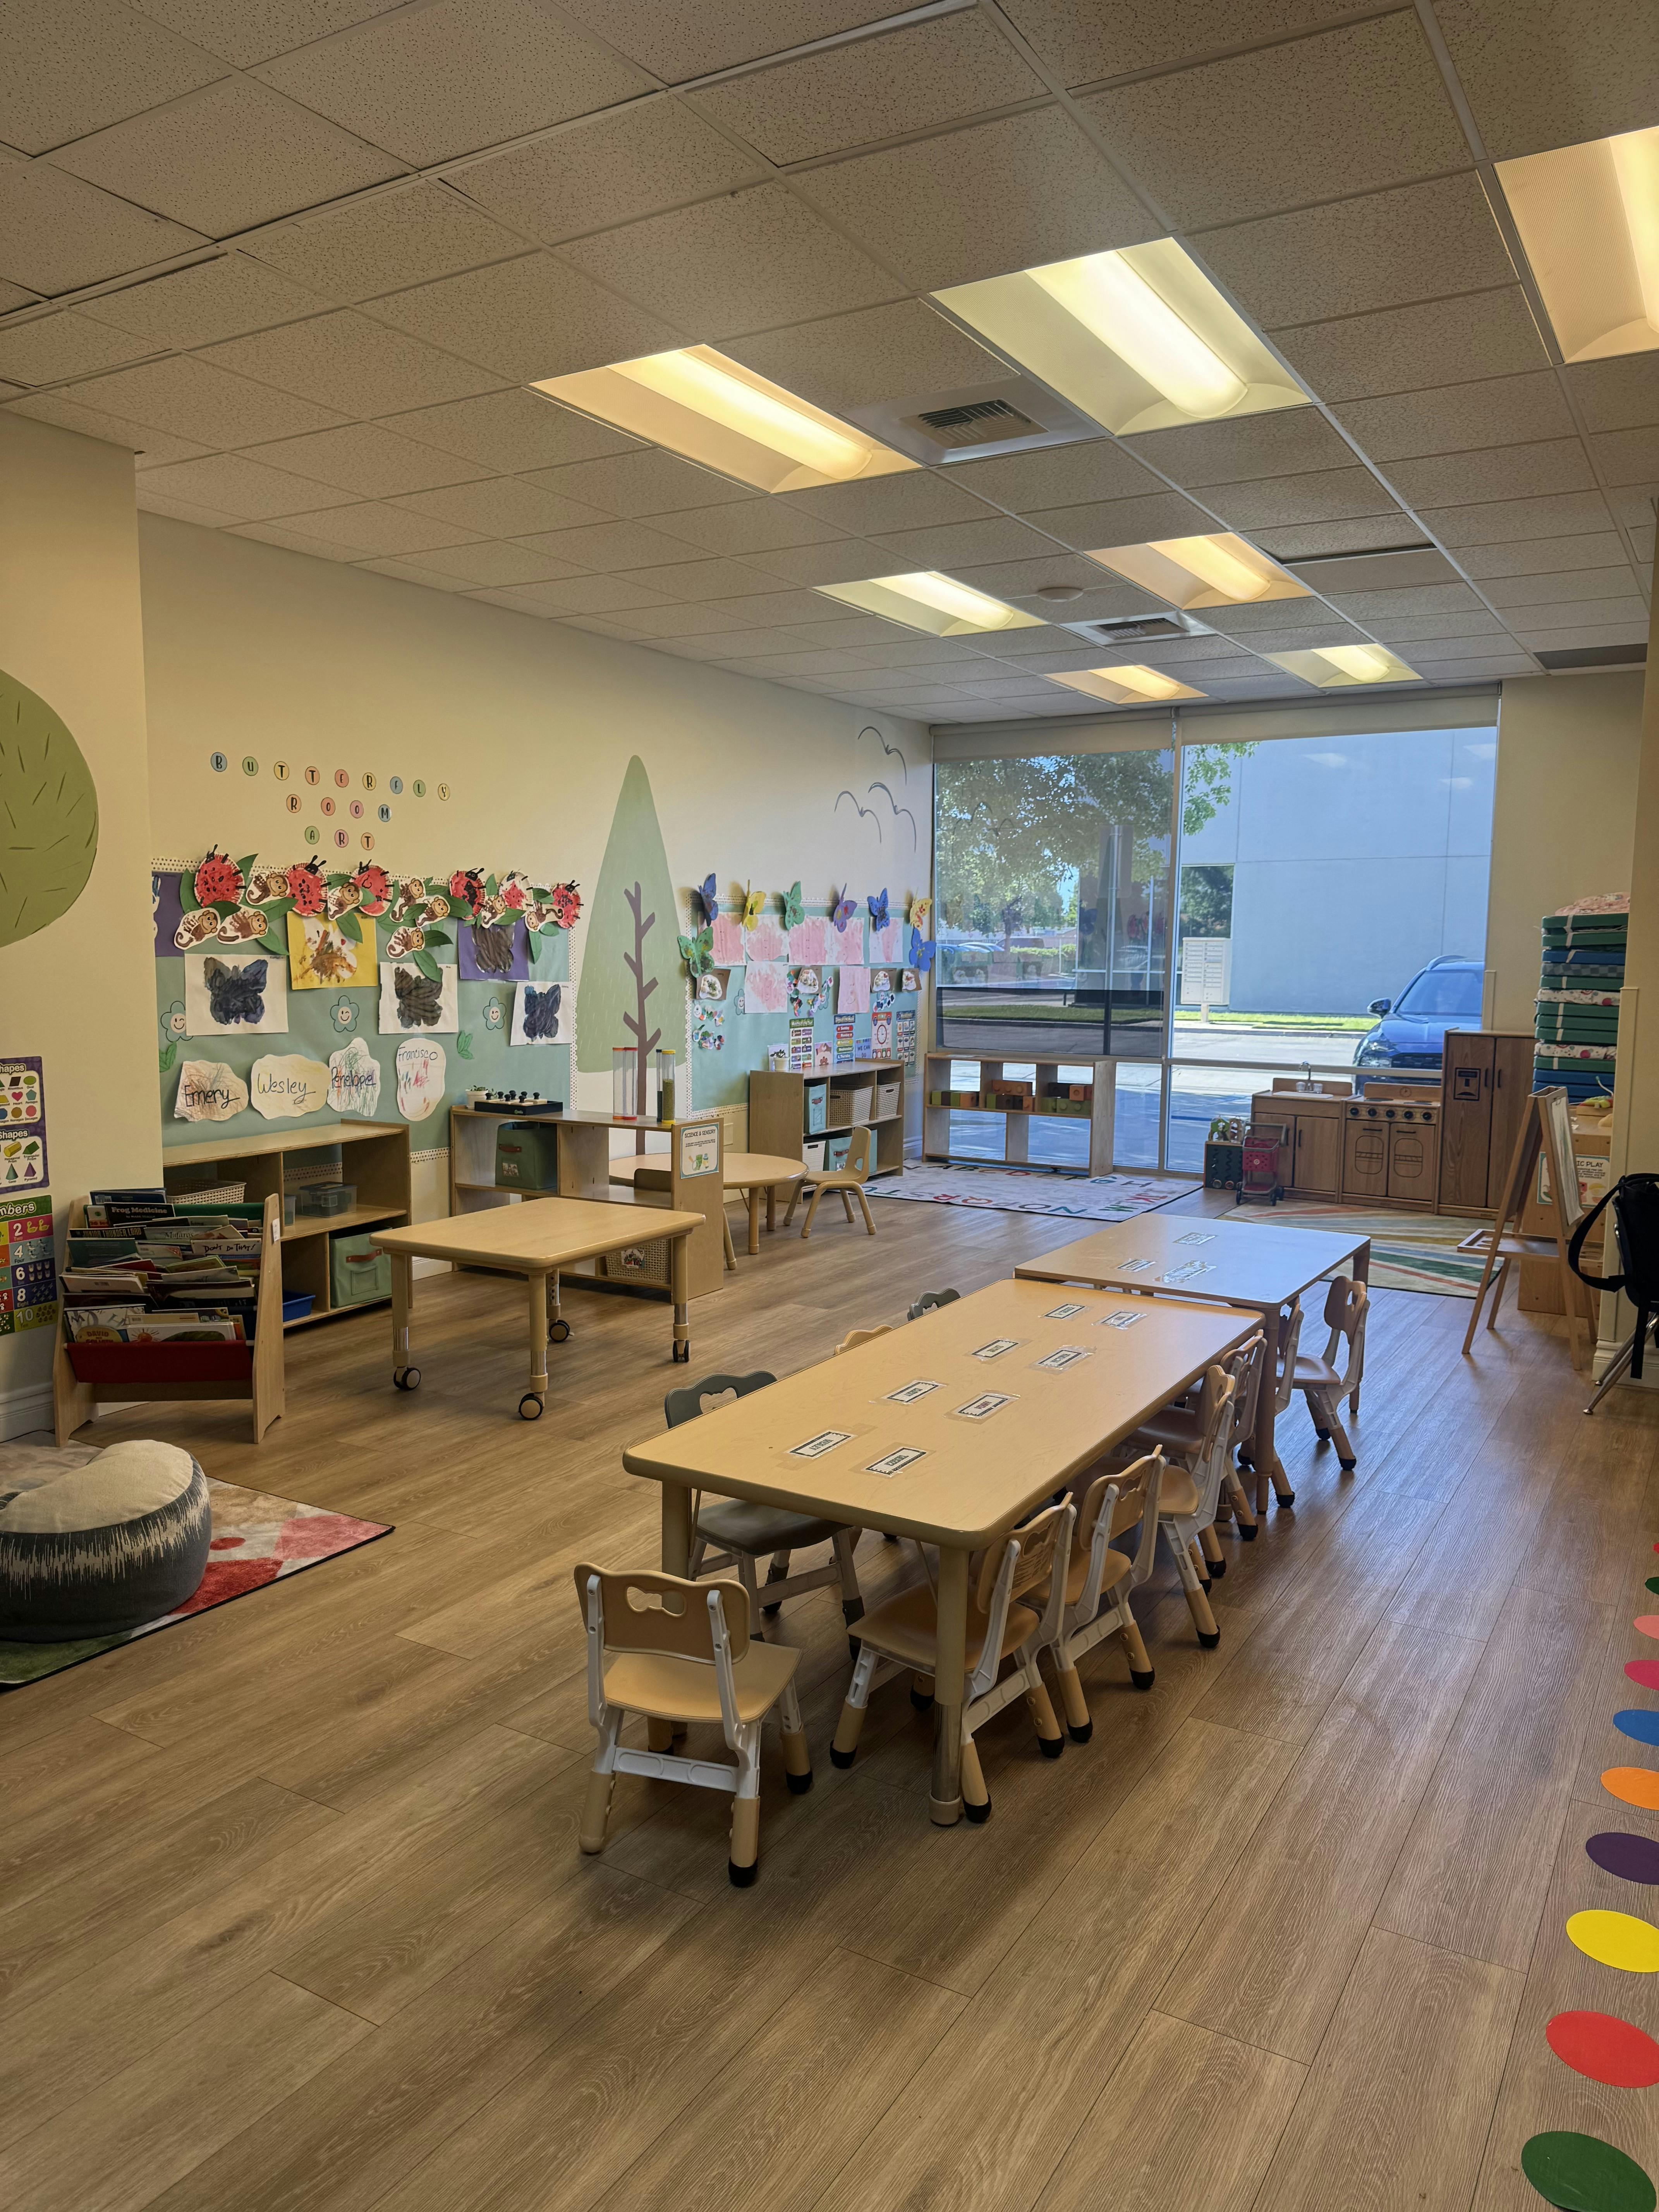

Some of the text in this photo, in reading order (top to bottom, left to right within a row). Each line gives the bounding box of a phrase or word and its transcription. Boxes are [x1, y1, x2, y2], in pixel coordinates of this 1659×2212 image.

[291, 797, 388, 819] ROOM
[310, 831, 371, 847] ART
[398, 1046, 438, 1061] Francisco
[0, 1065, 25, 1074] hapes
[331, 1067, 376, 1089] Penelope
[258, 1073, 316, 1104] Wesley
[184, 1085, 240, 1109] Emery
[0, 1204, 35, 1216] mbers
[13, 1223, 23, 1237] 2
[102, 1228, 127, 1237] THUNDER
[127, 1227, 142, 1235] LORD
[14, 1245, 23, 1258] 4
[16, 1267, 25, 1280] 6
[17, 1288, 26, 1302] 8
[16, 1309, 33, 1324] 10
